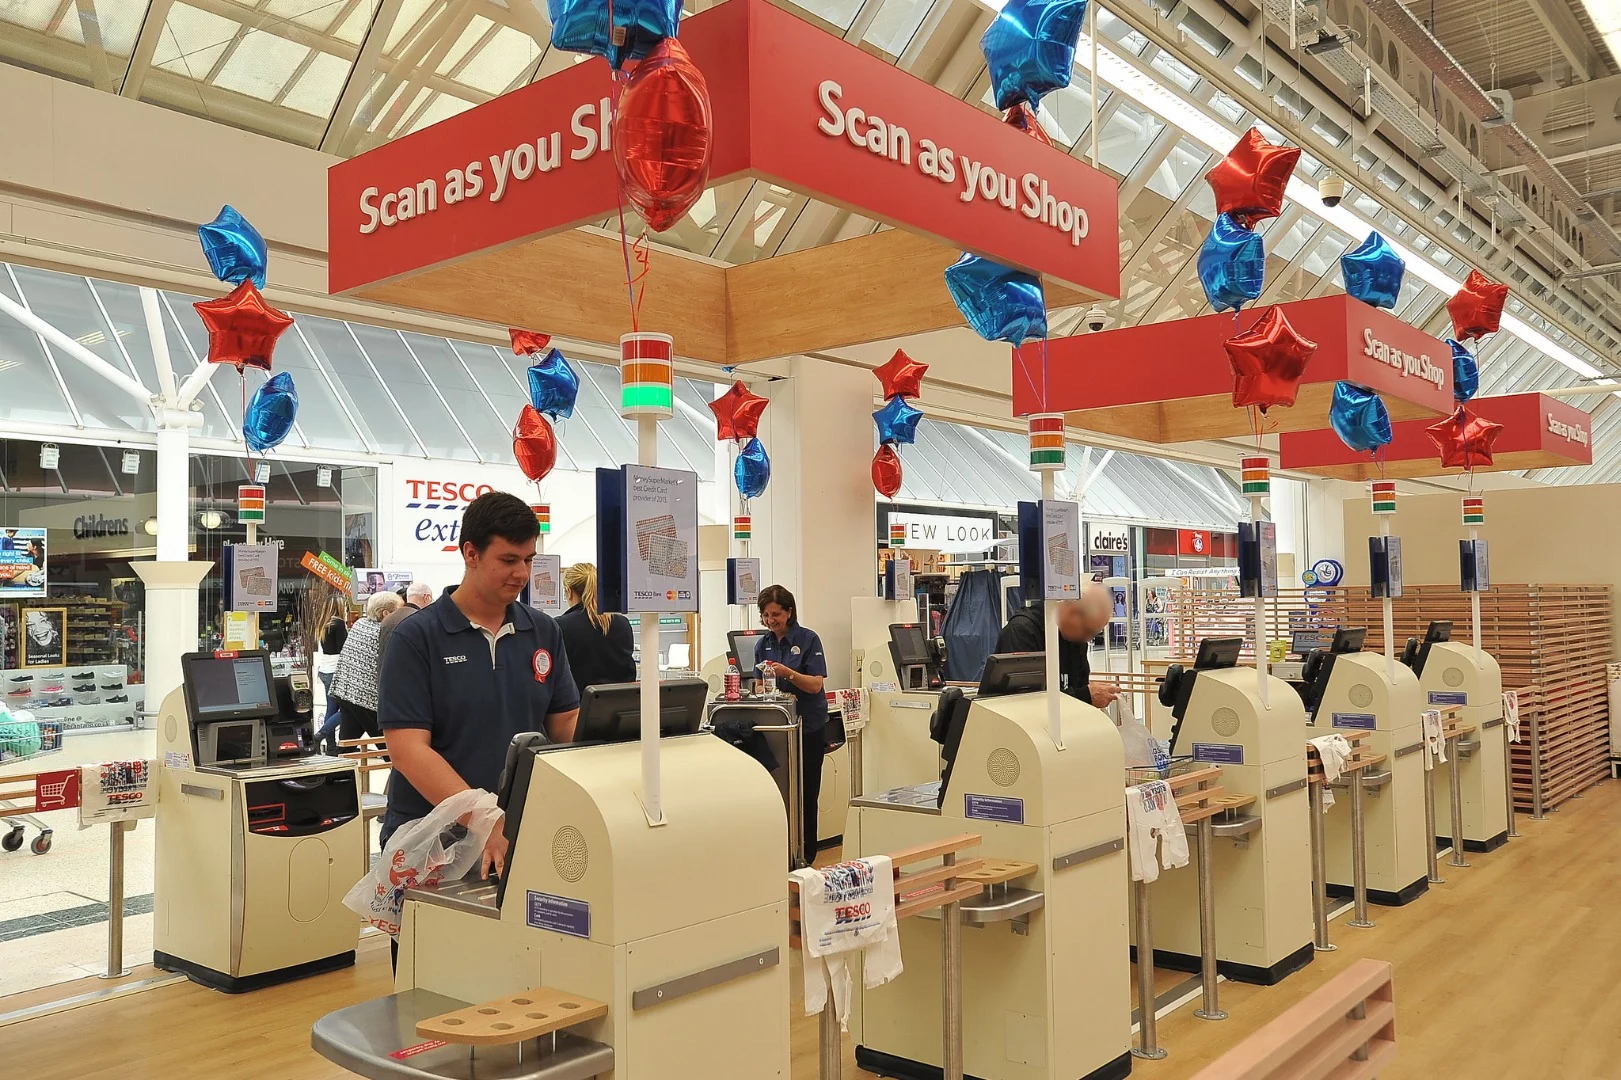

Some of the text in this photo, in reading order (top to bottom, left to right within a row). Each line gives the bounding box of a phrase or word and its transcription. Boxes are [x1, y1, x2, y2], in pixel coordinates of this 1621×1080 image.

[817, 79, 1090, 247] Scan as you Shop
[359, 176, 437, 235] Scan
[443, 160, 484, 205] as
[489, 130, 562, 203] you
[1363, 327, 1444, 391] Scan as you Shop
[1547, 412, 1561, 435] Scan
[1575, 423, 1588, 448] Shop
[73, 513, 129, 540] Childrens
[415, 518, 460, 541] ext
[946, 525, 991, 541] LOOK
[1094, 530, 1128, 550] claire's
[308, 557, 328, 575] FREE
[327, 569, 344, 586] kids
[322, 555, 339, 569] Come
[1208, 568, 1237, 576] Anything
[443, 655, 467, 663] TESCO
[106, 792, 143, 801] TESCO
[834, 902, 871, 920] TESCO
